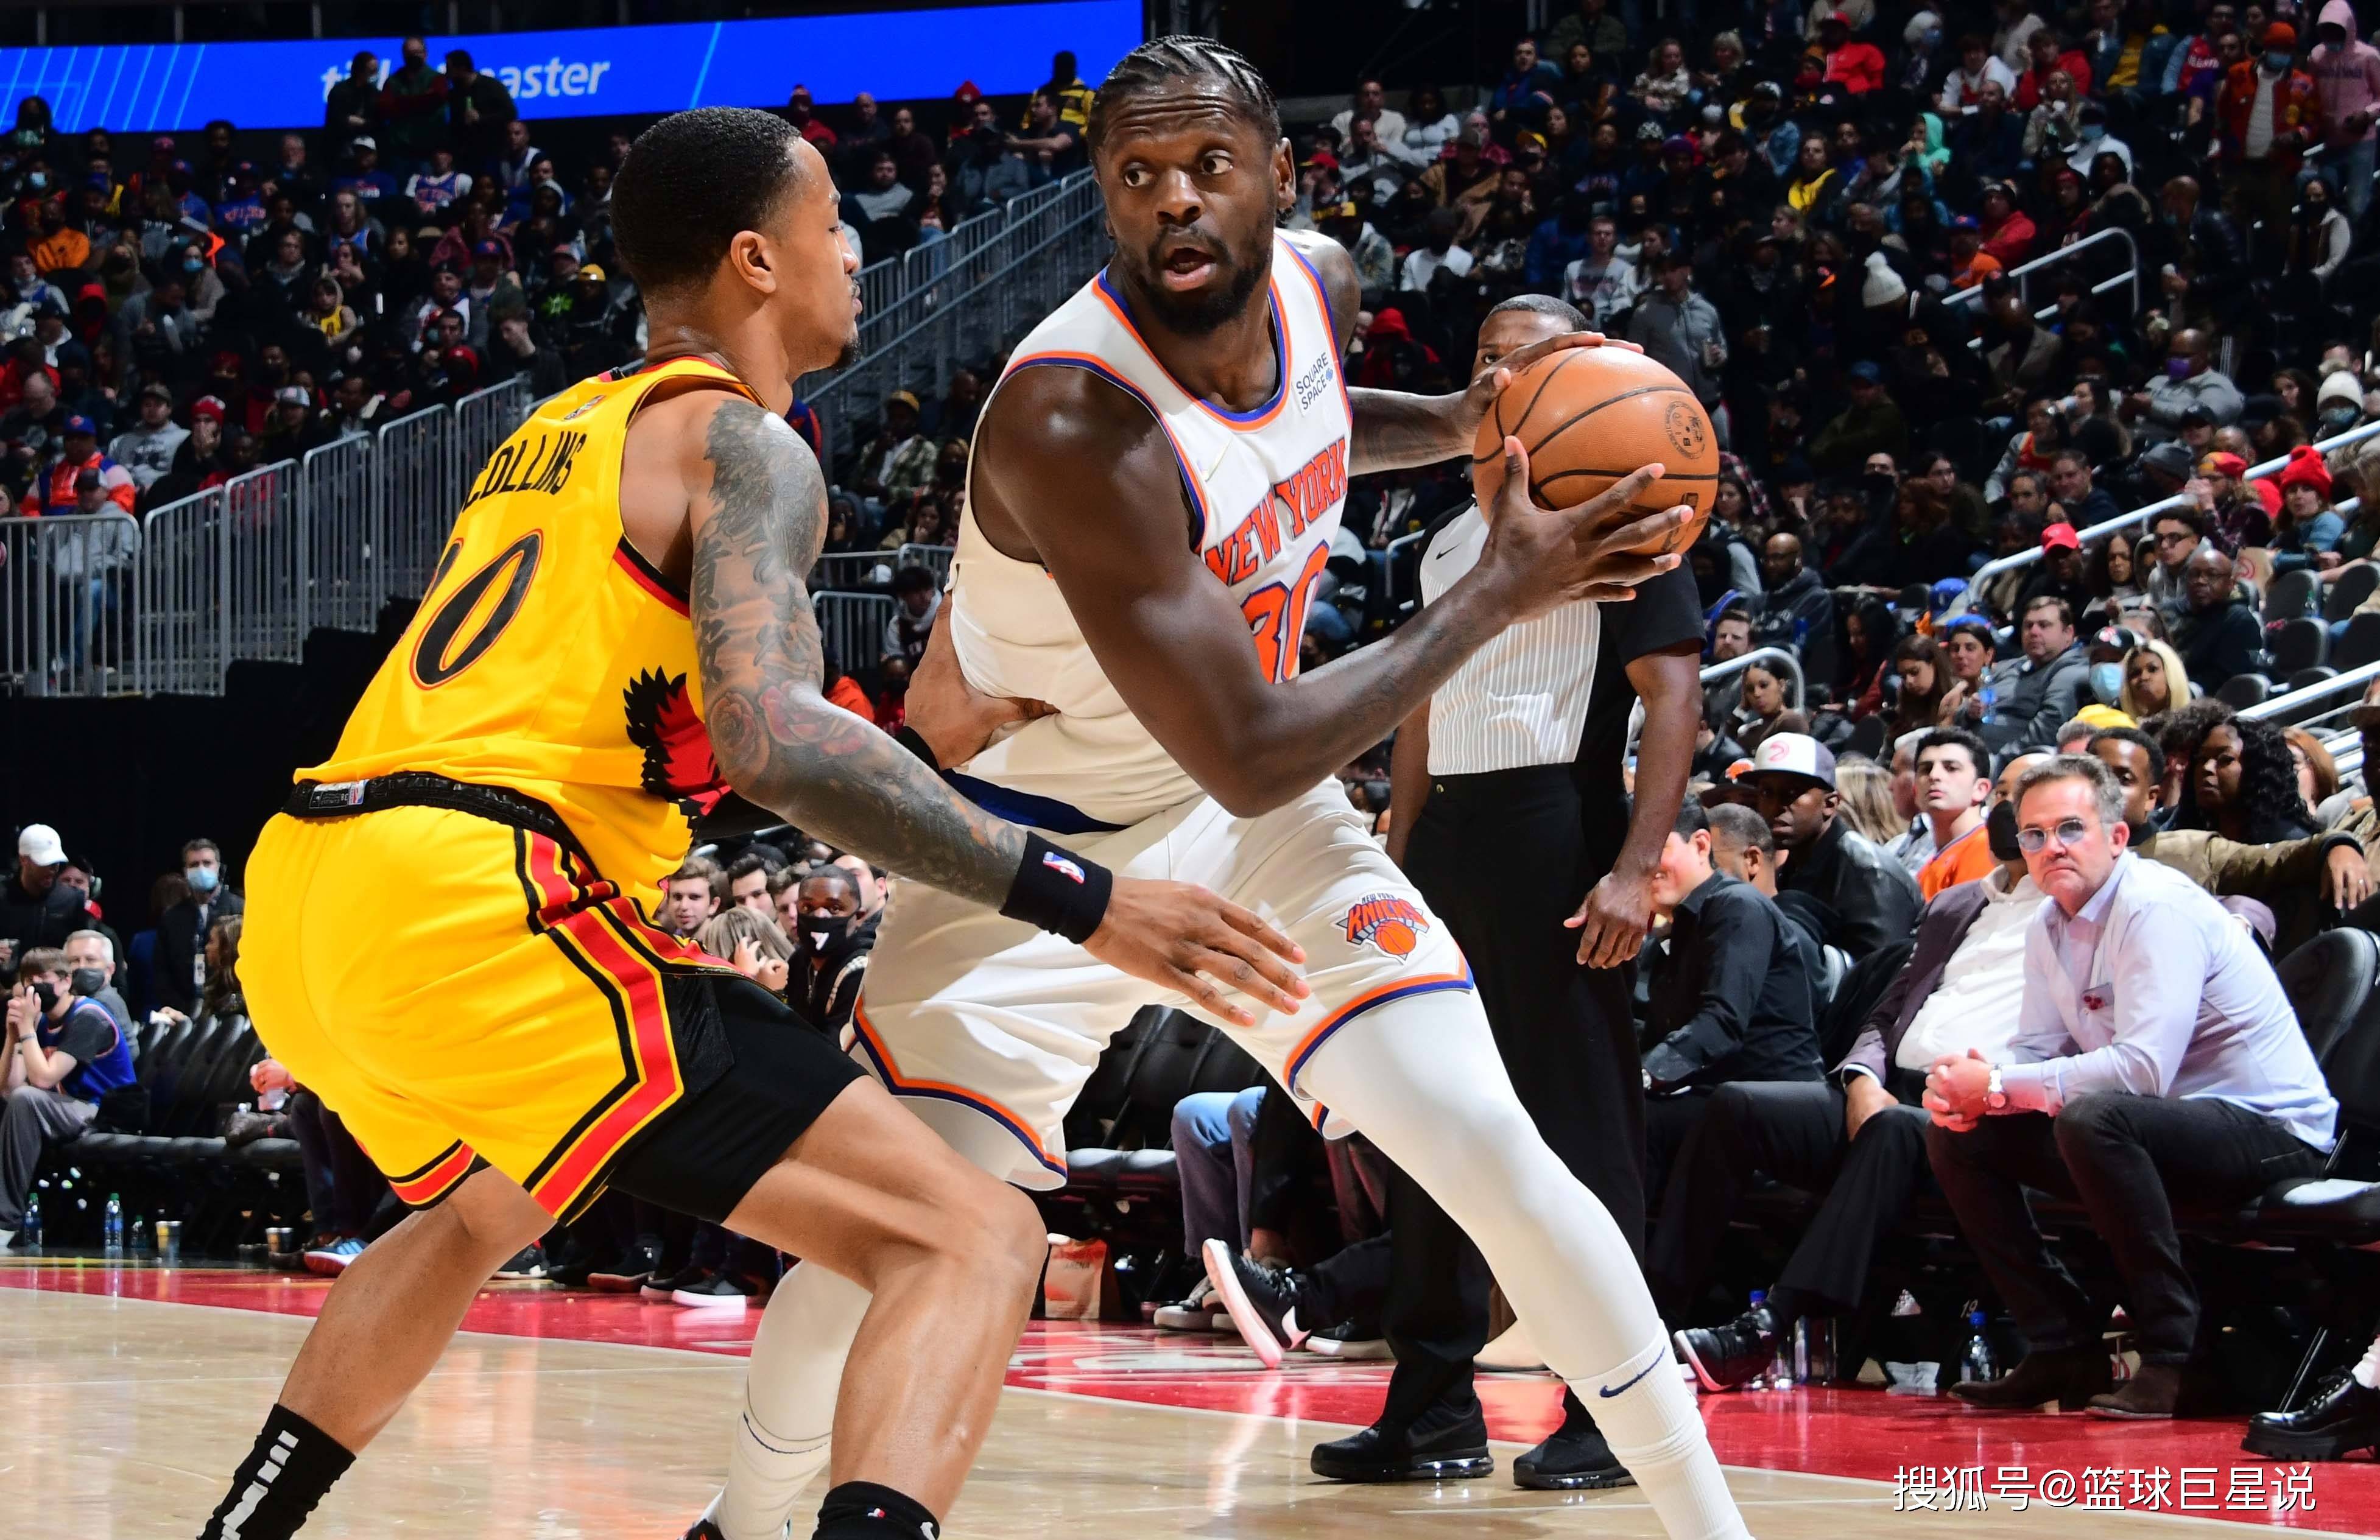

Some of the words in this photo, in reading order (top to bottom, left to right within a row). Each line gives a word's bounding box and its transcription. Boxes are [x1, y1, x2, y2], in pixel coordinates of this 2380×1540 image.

[1296, 352, 1328, 395] SQUARE
[1301, 374, 1326, 410] SPACE
[1205, 489, 1282, 586] NEW
[1273, 437, 1348, 540] YORK
[1362, 893, 1376, 904] NEW
[1347, 898, 1430, 943] KNICKS
